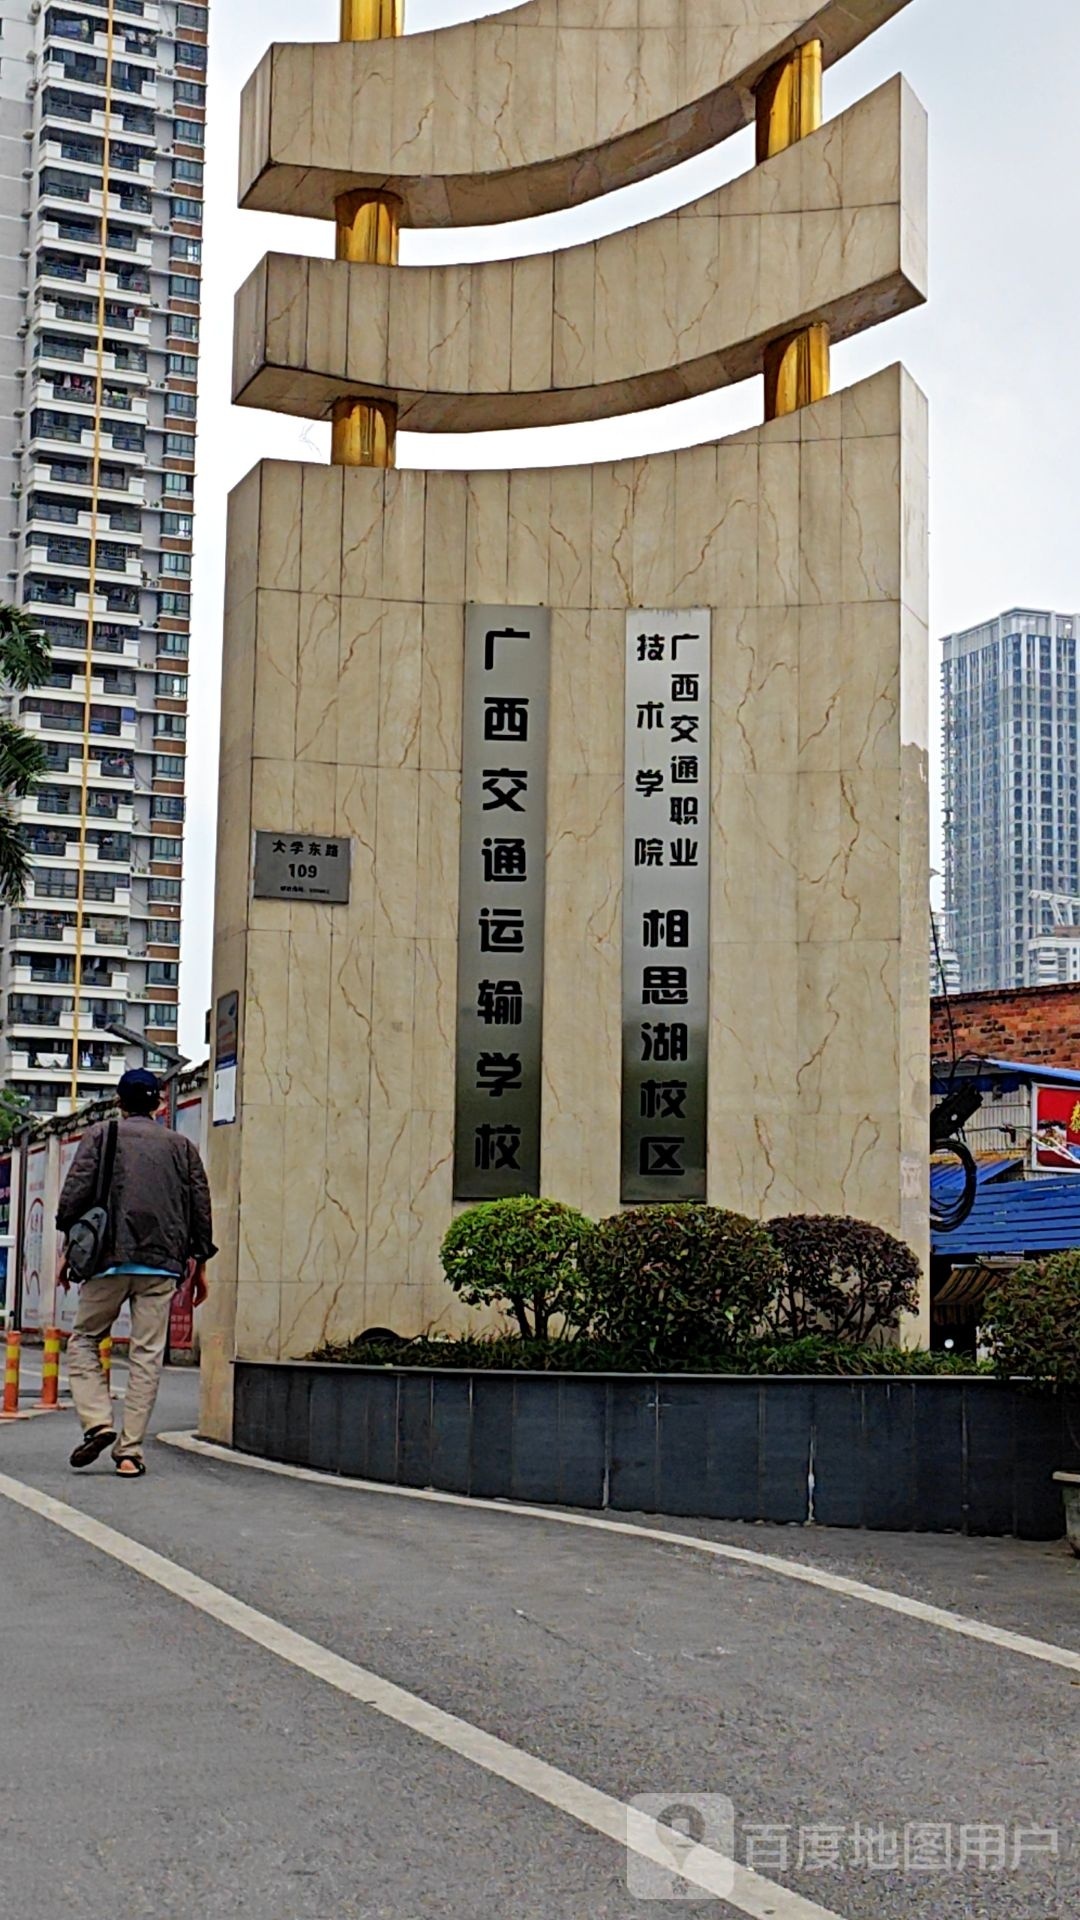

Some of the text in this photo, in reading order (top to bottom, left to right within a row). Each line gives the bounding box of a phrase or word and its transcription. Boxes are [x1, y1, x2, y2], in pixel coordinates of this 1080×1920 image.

[272, 839, 339, 858] 大学东路
[634, 633, 665, 868] 技术学院
[670, 633, 700, 868] 广西交通职业
[288, 863, 318, 878] 109
[474, 628, 531, 1171] 广西交通运输学校
[640, 909, 690, 1177] 相思湖校区
